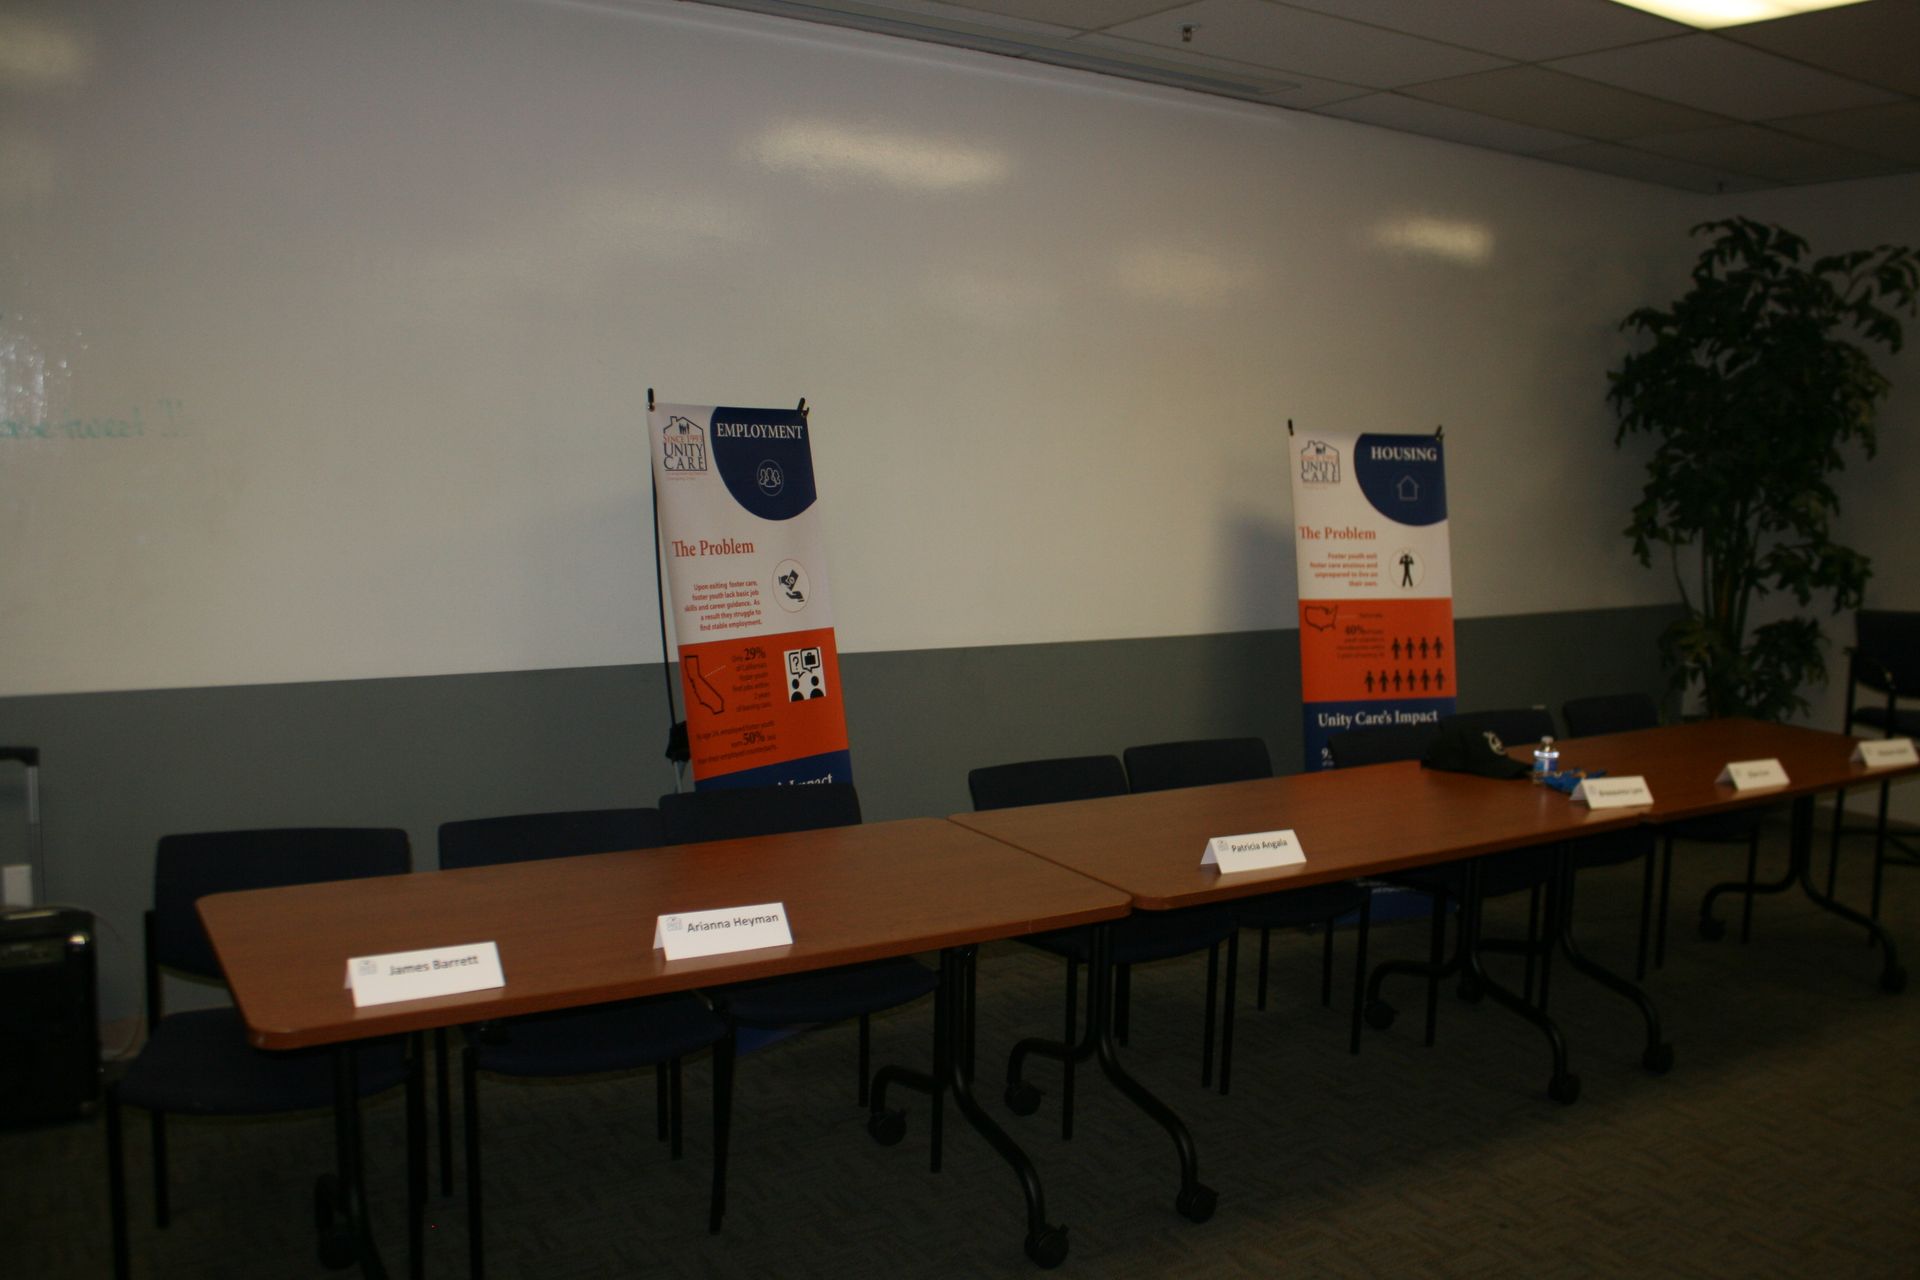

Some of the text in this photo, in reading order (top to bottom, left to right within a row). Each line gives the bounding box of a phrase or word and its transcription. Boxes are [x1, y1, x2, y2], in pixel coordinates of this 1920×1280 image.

[717, 423, 803, 439] EMPLOYMENT
[664, 443, 703, 457] UNITY
[1370, 446, 1437, 461] HOUSING
[664, 456, 704, 470] CARE
[1301, 461, 1337, 473] UNITY
[1299, 526, 1377, 540] The Problem
[672, 538, 755, 557] The Problem
[694, 583, 708, 591] Upon
[709, 582, 728, 590] exiting
[708, 592, 724, 601] youth
[750, 589, 759, 598] job
[684, 604, 698, 612] skills
[720, 611, 733, 620] they
[733, 610, 755, 619] struggle
[711, 622, 728, 630] stable
[743, 646, 767, 661] 29%
[1318, 710, 1438, 729] Unity Care's Impact
[1231, 844, 1261, 853] Patricia
[687, 922, 731, 933] Arianna
[733, 914, 779, 927] Heyman
[389, 963, 430, 976] James
[432, 955, 479, 970] Barrett
